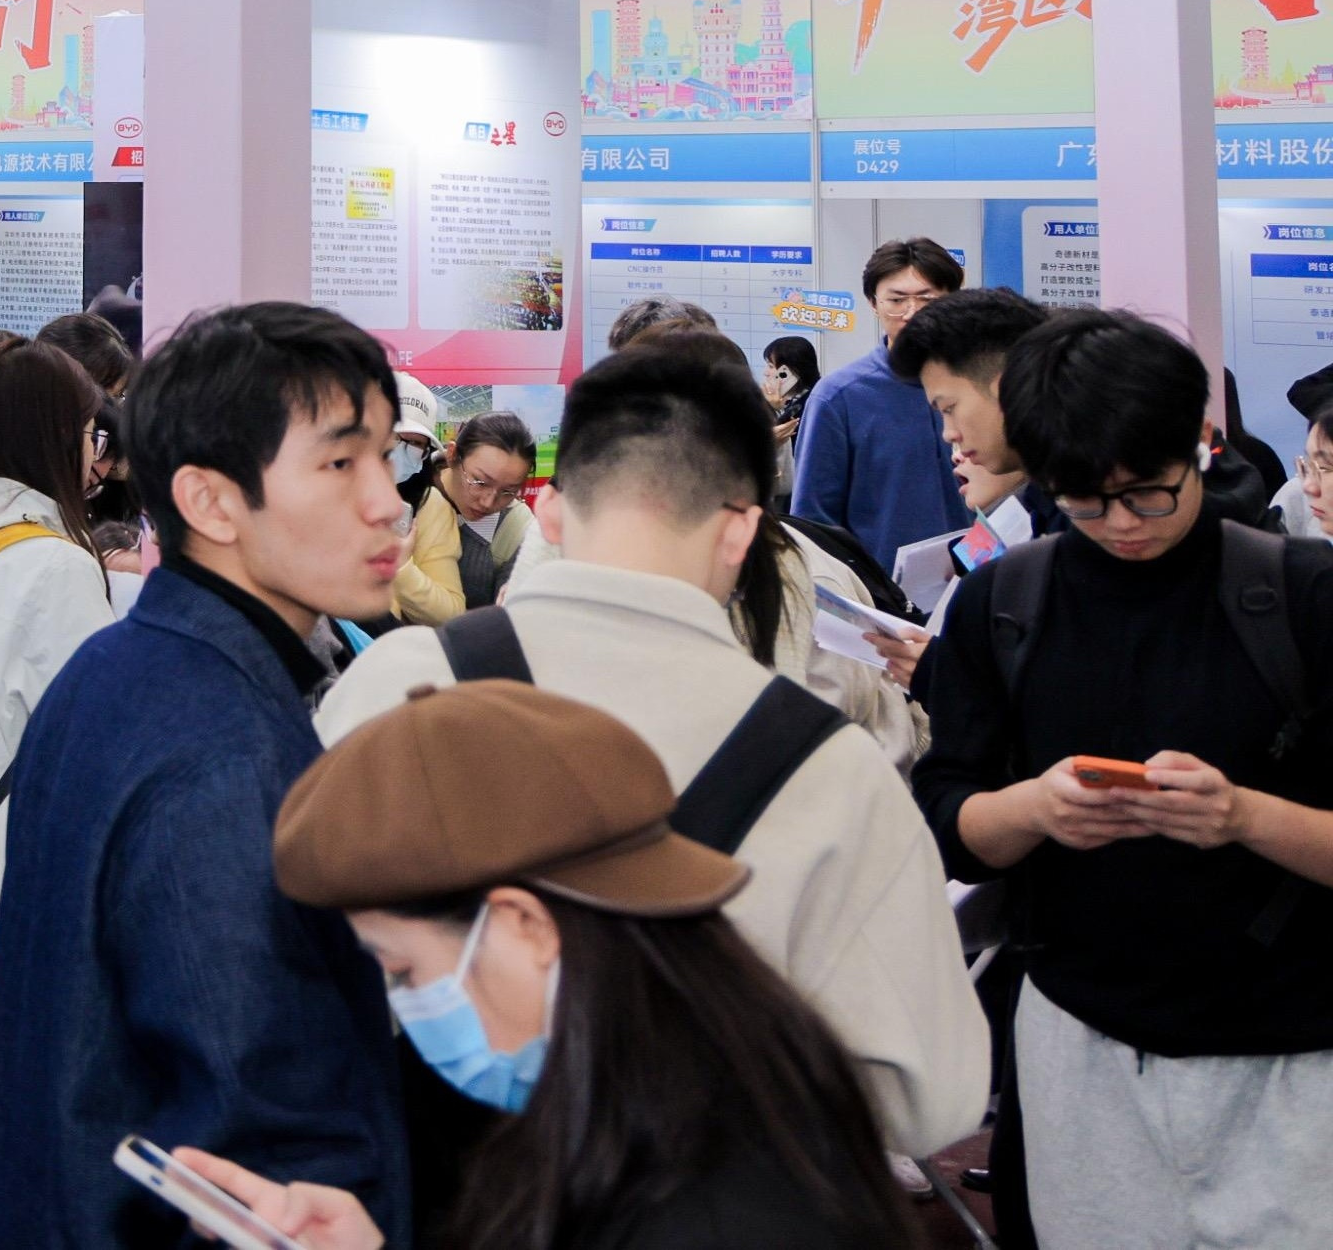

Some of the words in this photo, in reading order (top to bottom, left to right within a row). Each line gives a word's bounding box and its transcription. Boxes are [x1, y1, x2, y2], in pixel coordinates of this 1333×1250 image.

[118, 124, 140, 132] BYD
[546, 120, 564, 129] BYD
[853, 140, 902, 156] 展位号
[131, 150, 142, 164] 招
[581, 147, 671, 170] 有限公司
[856, 159, 899, 174] D429
[1053, 224, 1099, 235] 用人单位
[1278, 227, 1325, 239] 岗位信息
[780, 305, 849, 328] 欢迎您来
